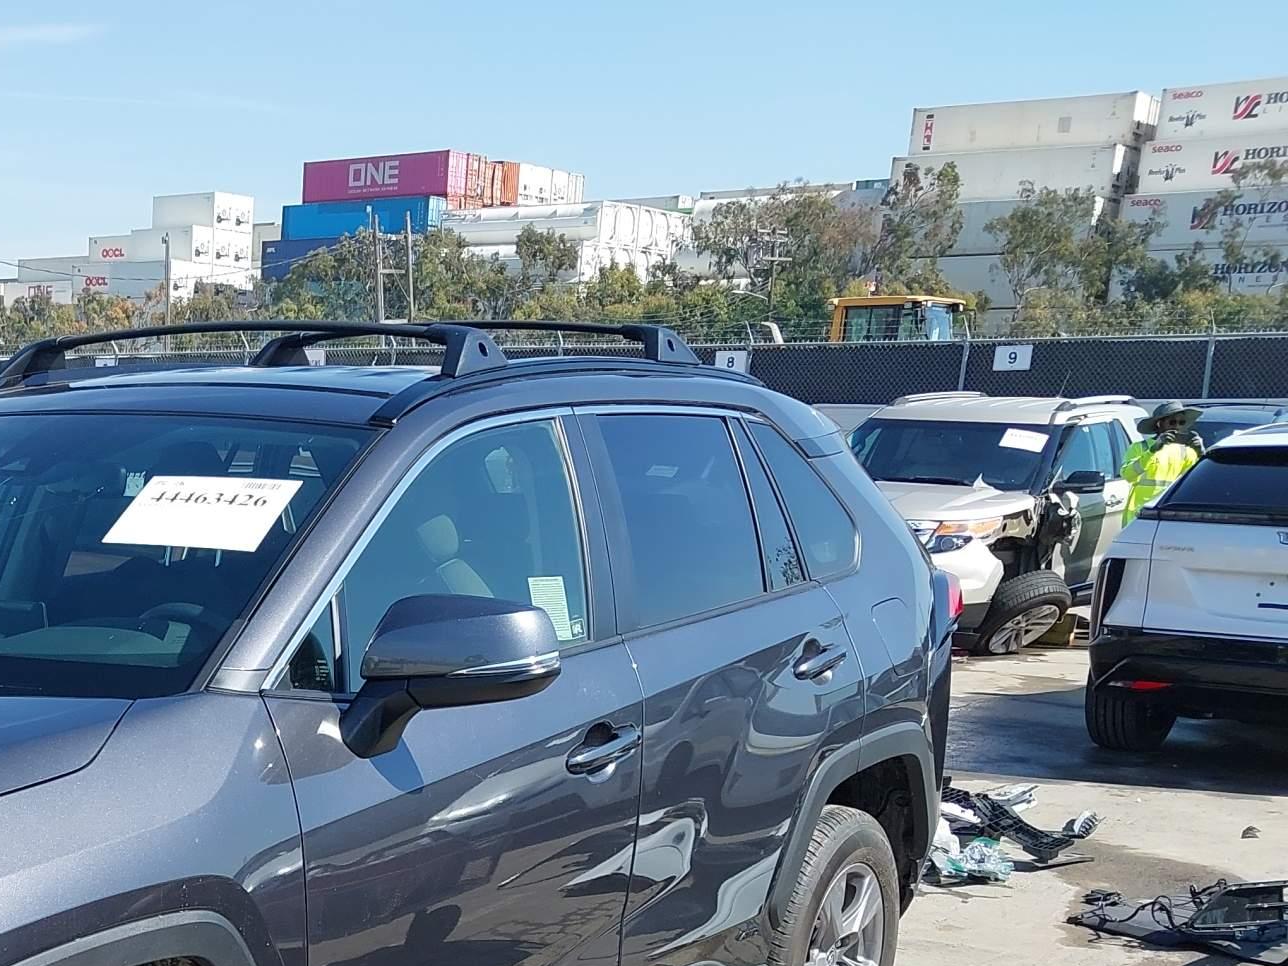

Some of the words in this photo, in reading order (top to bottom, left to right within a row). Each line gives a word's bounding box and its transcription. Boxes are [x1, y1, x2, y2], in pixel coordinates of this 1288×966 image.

[1172, 90, 1204, 100] seaco
[1152, 144, 1182, 154] seaco
[349, 161, 400, 187] ONE
[102, 248, 125, 258] OOCL
[85, 277, 108, 287] OOCL
[727, 356, 735, 368] 8
[1008, 352, 1018, 364] 9
[150, 490, 268, 507] 44463426
